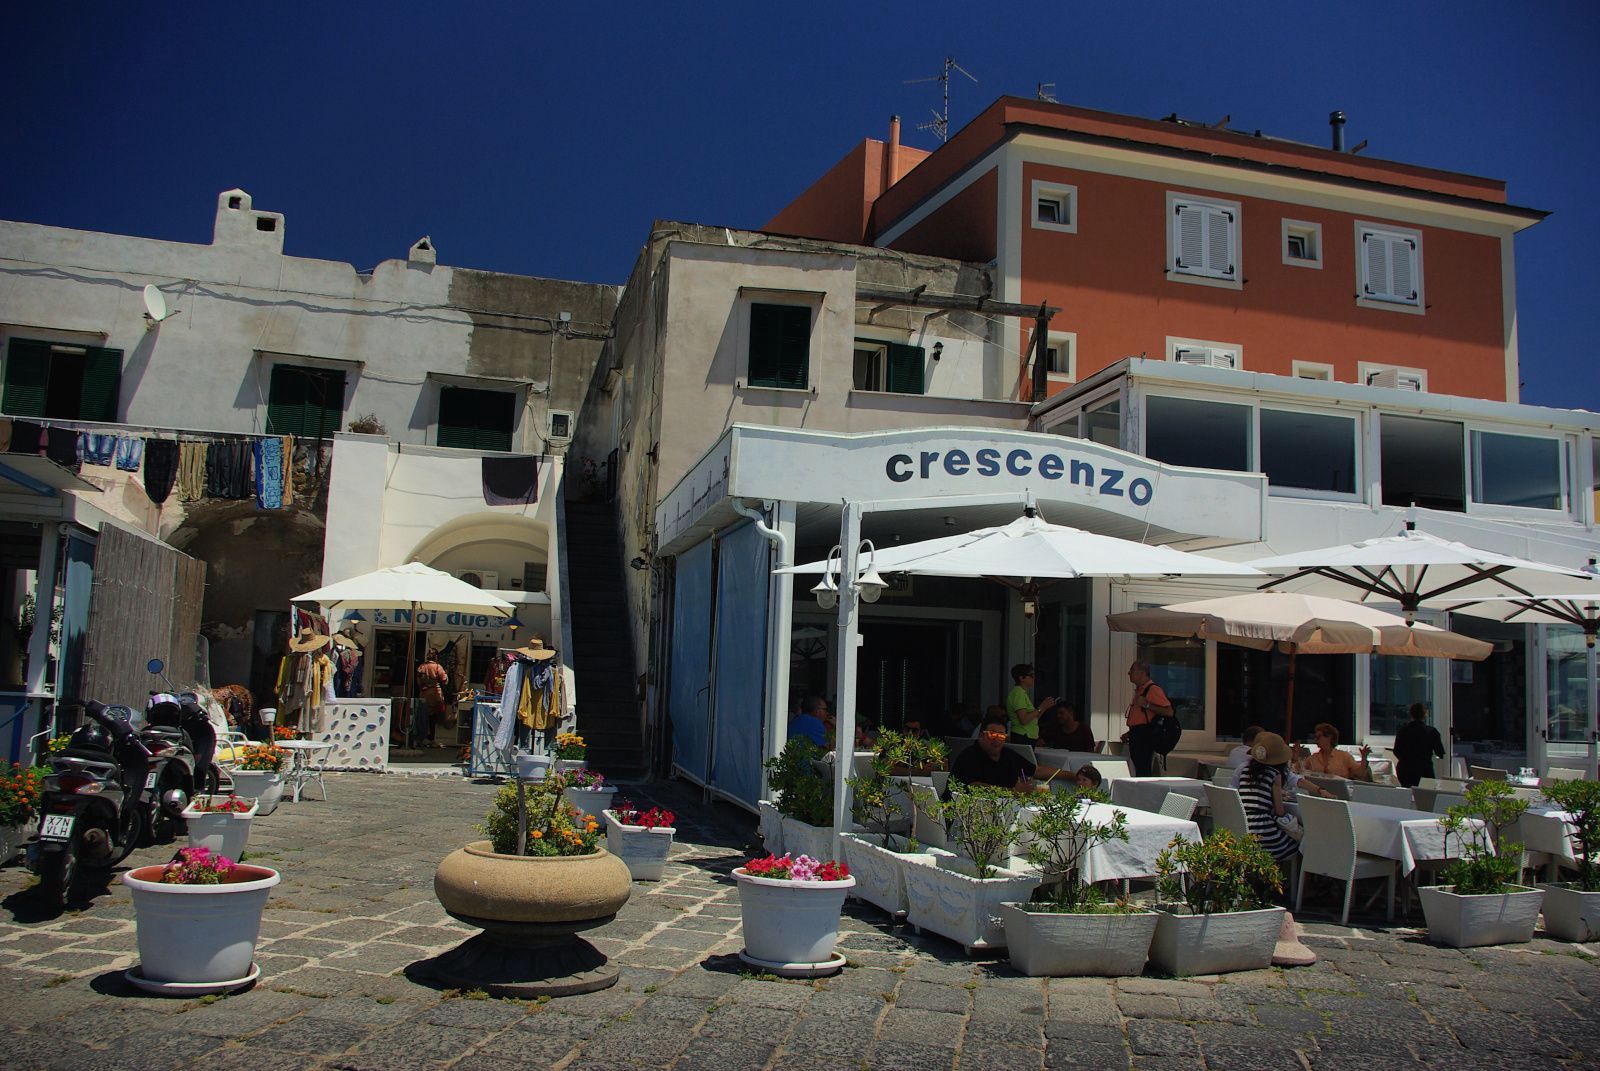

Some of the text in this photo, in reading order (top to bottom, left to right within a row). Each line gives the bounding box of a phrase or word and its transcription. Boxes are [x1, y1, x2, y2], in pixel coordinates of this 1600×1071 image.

[886, 448, 1154, 506] crescenzo
[394, 609, 437, 625] Noi
[446, 611, 489, 627] due
[46, 825, 68, 836] VLH
